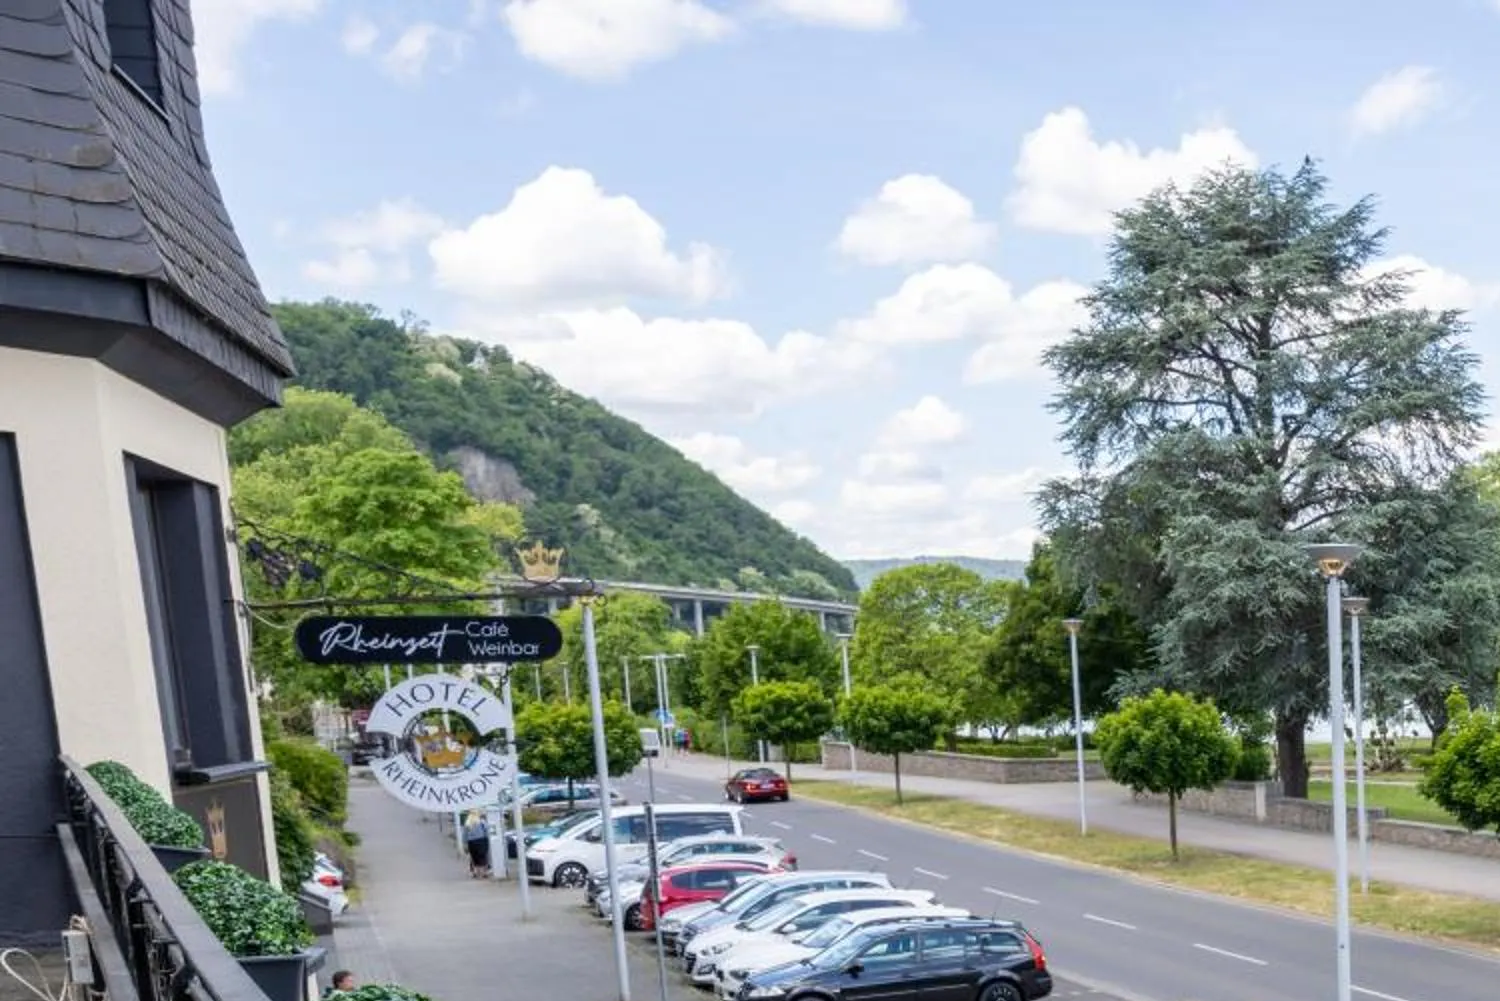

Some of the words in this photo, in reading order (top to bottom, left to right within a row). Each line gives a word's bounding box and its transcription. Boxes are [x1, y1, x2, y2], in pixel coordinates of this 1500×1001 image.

[319, 621, 465, 657] Rheinzeit
[465, 621, 510, 638] Café
[468, 640, 541, 656] Weinbar
[385, 682, 487, 718] HOTEL
[381, 757, 506, 805] RHEINKRONE
